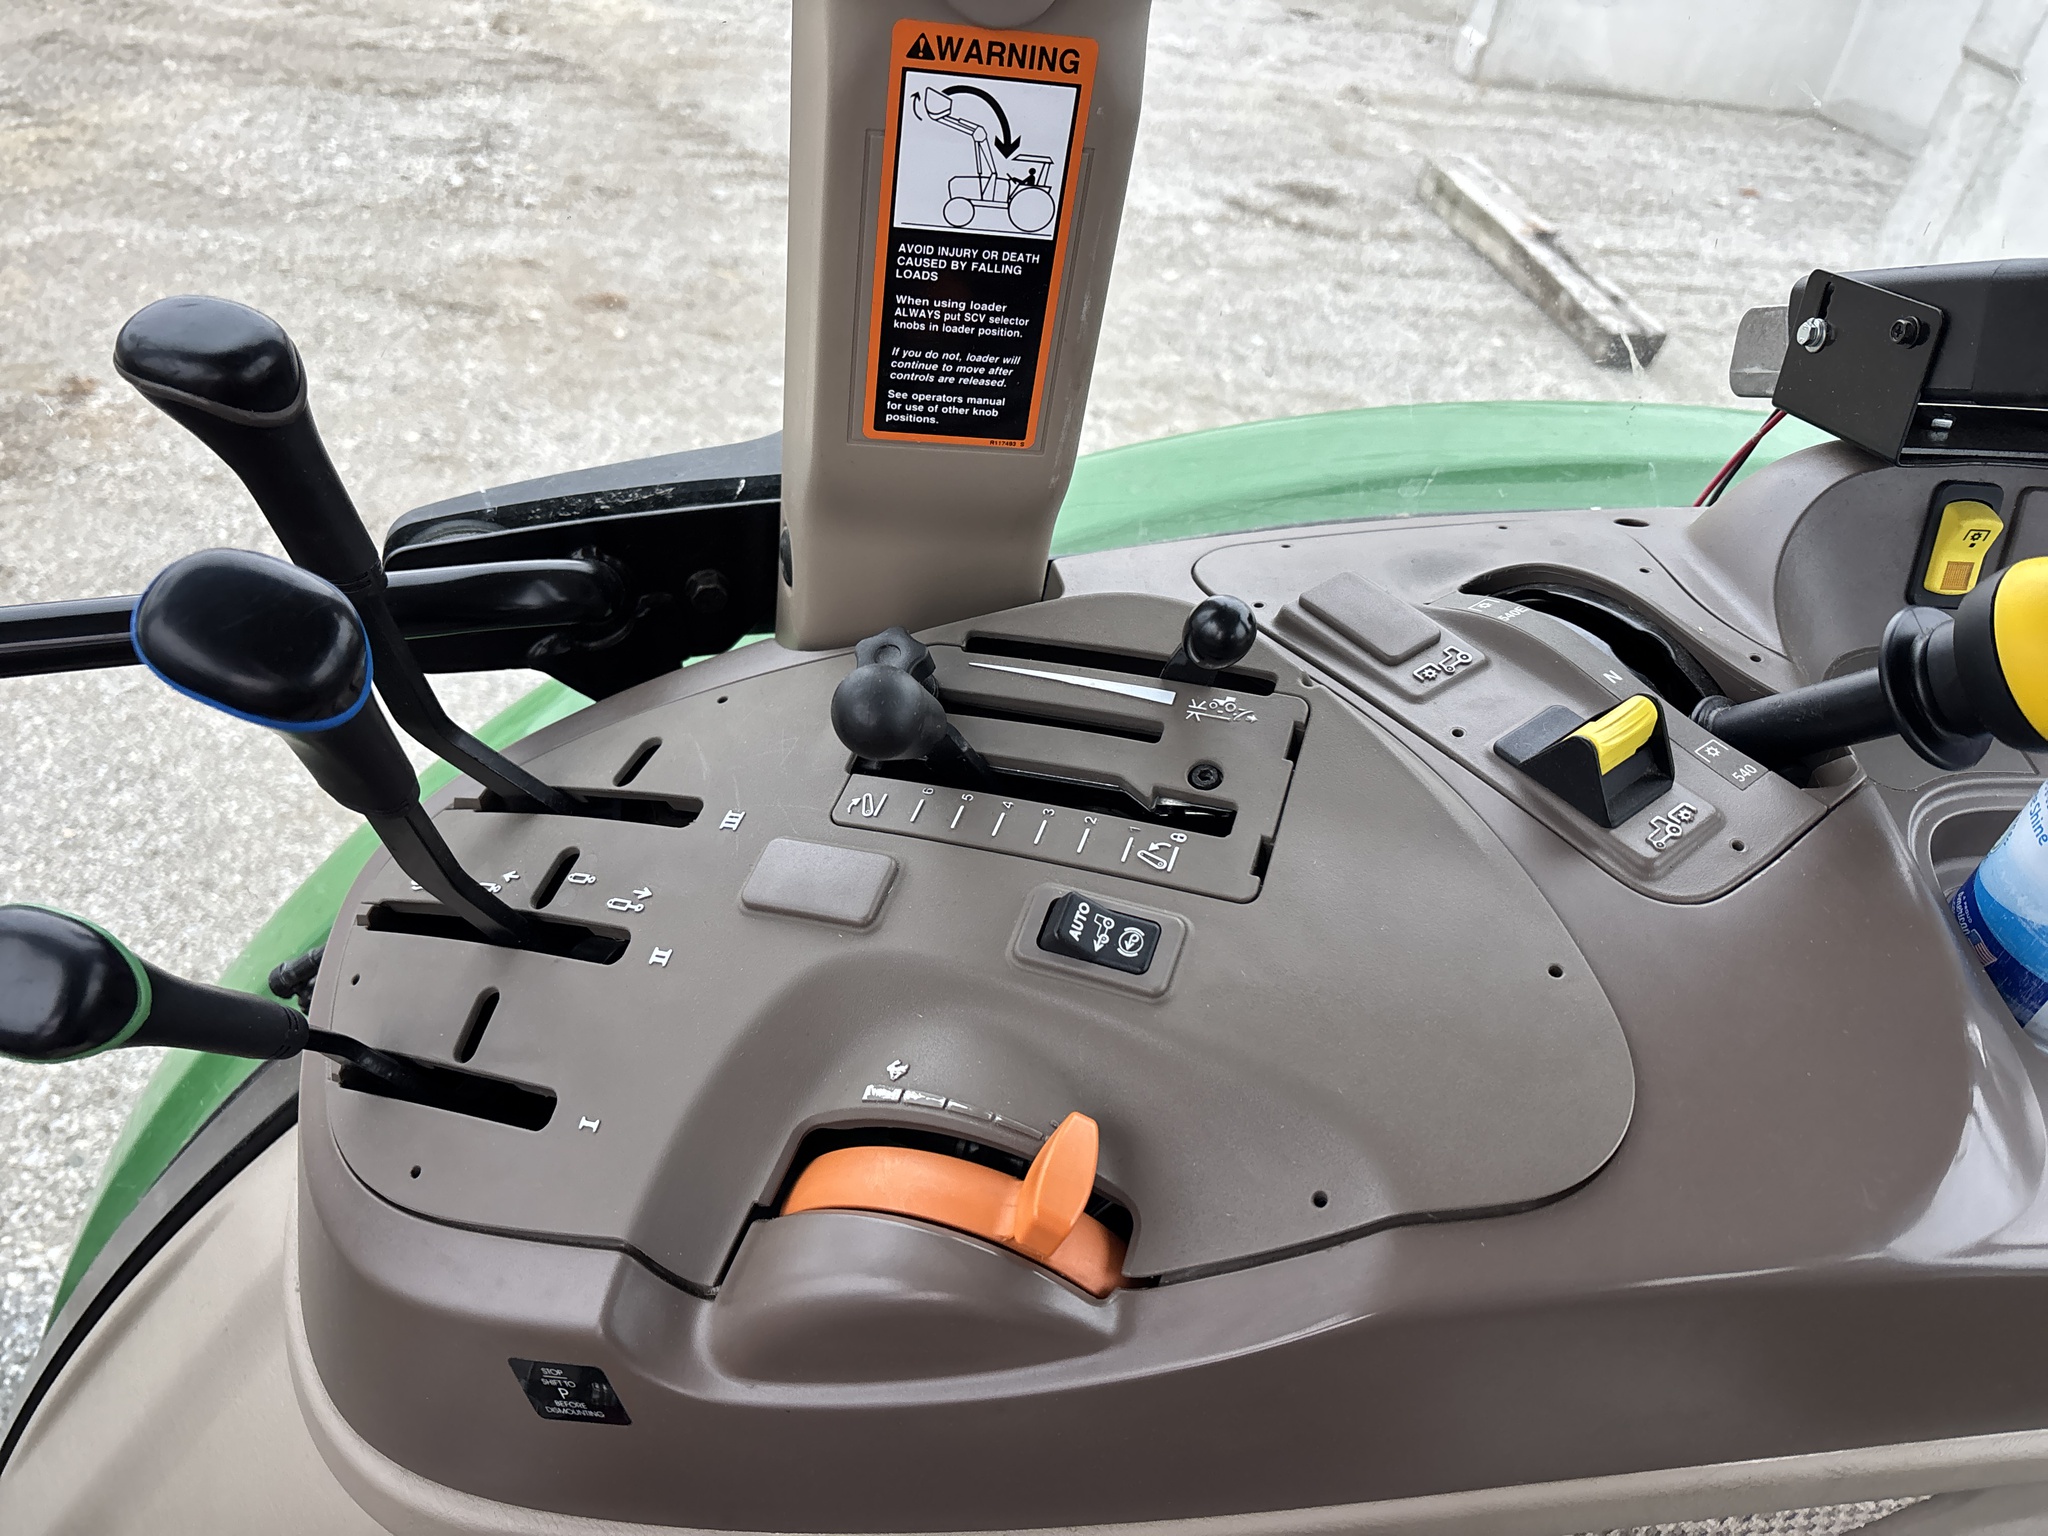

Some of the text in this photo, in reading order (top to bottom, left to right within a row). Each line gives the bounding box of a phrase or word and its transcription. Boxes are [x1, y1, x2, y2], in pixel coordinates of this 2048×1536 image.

[936, 35, 1080, 74] WARNING
[898, 243, 1040, 264] AVOID INJURY OR DEATH
[897, 256, 1022, 275] CAUSED BY FALLING
[895, 269, 938, 281] LOADS
[896, 294, 1007, 312] When using loader
[894, 307, 1030, 326] ALWAYS put SCV selector
[893, 319, 1023, 338] knobs in loader position.
[891, 347, 1021, 365] If you do not, loader will
[890, 360, 1014, 376] continue to move after
[889, 371, 1007, 388] controls are released.
[887, 389, 1006, 406] See operators manual
[886, 401, 999, 417] for use of other knob
[885, 412, 939, 424] positions.
[1497, 605, 1529, 621] 540E
[1602, 670, 1623, 684] N
[1731, 764, 1757, 782] 540
[922, 787, 934, 795] 6
[961, 793, 974, 802] 5
[1002, 801, 1014, 809] 4
[1042, 808, 1055, 816] 3
[1084, 816, 1097, 825] 2
[719, 810, 746, 831] III
[2029, 802, 2048, 847] Shine
[1069, 902, 1090, 942] AUTO
[649, 946, 673, 967] II
[541, 1367, 563, 1376] STOP
[541, 1378, 576, 1388] SHIFT TO
[557, 1387, 569, 1399] P
[545, 1406, 605, 1418] DISMOUNTING
[554, 1400, 588, 1409] BEFORE
